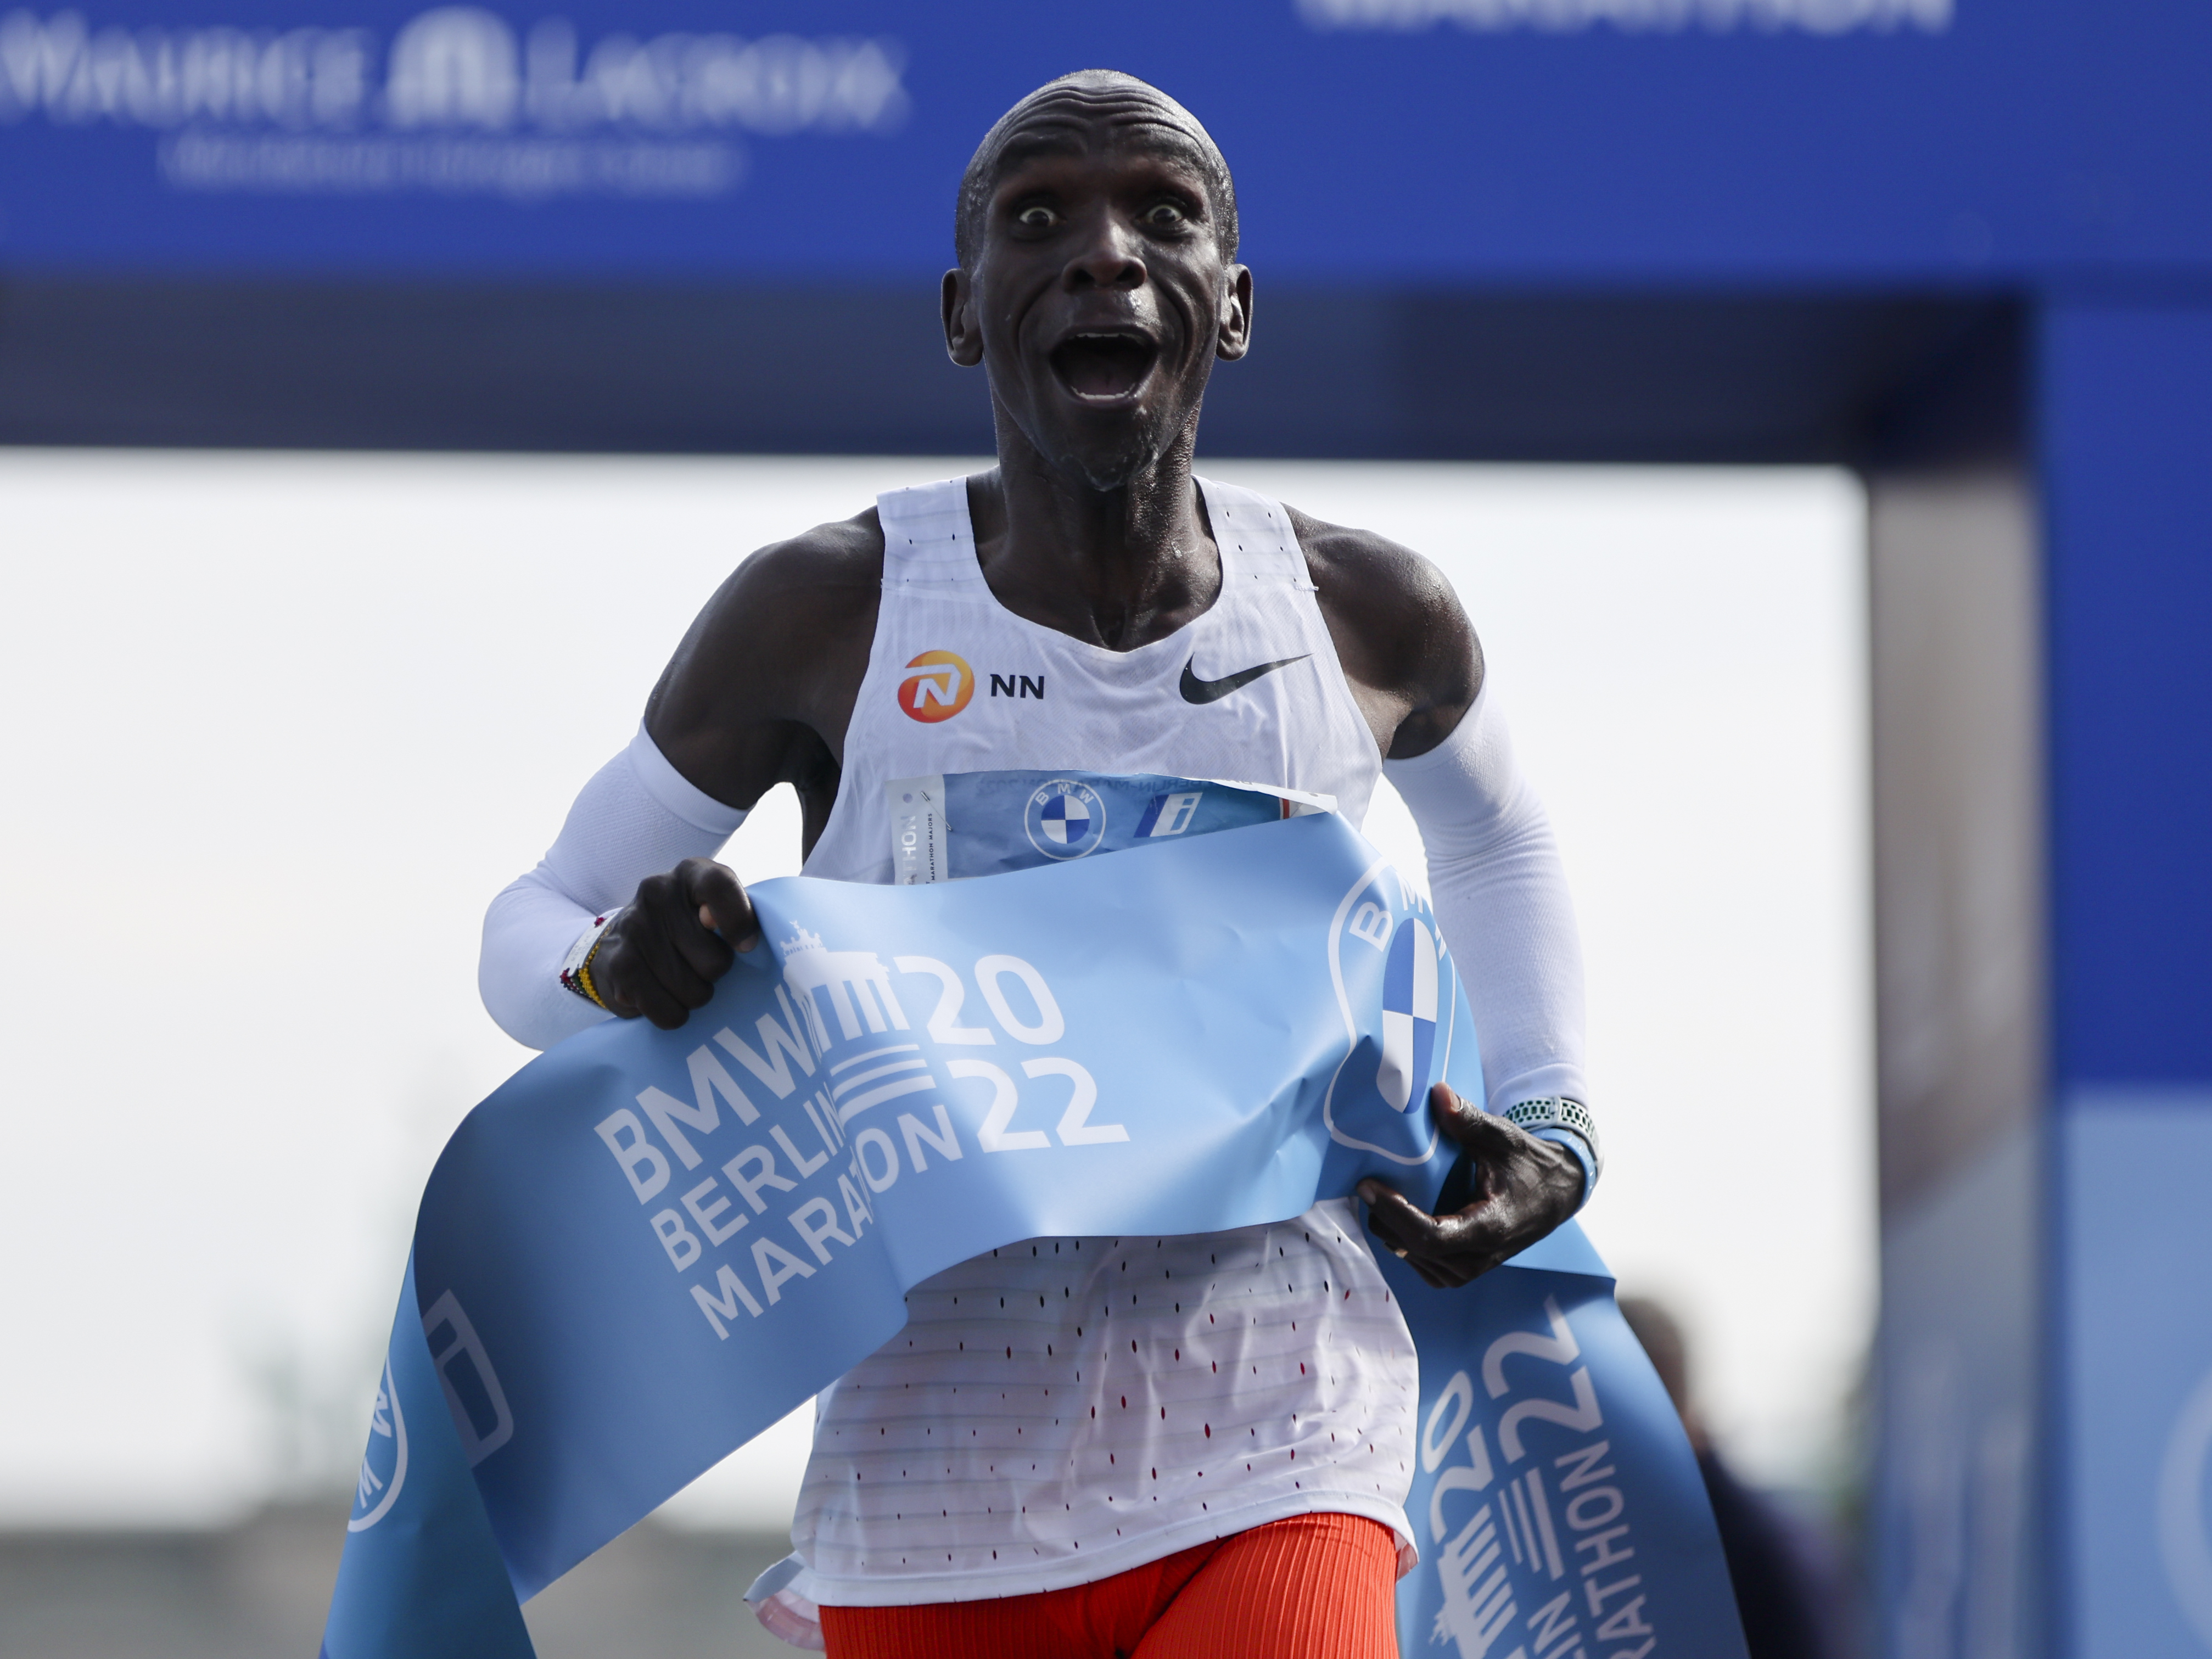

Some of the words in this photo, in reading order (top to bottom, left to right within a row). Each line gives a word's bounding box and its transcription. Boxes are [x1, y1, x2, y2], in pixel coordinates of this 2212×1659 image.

[989, 674, 1045, 700] NN
[1035, 783, 1094, 806] BMW
[893, 954, 1065, 1046] 20
[594, 984, 816, 1206] BMW
[945, 1057, 1130, 1153] 22
[649, 1081, 846, 1274] BERLIN
[1482, 1293, 1603, 1465] 22
[1421, 1370, 1494, 1545] 20
